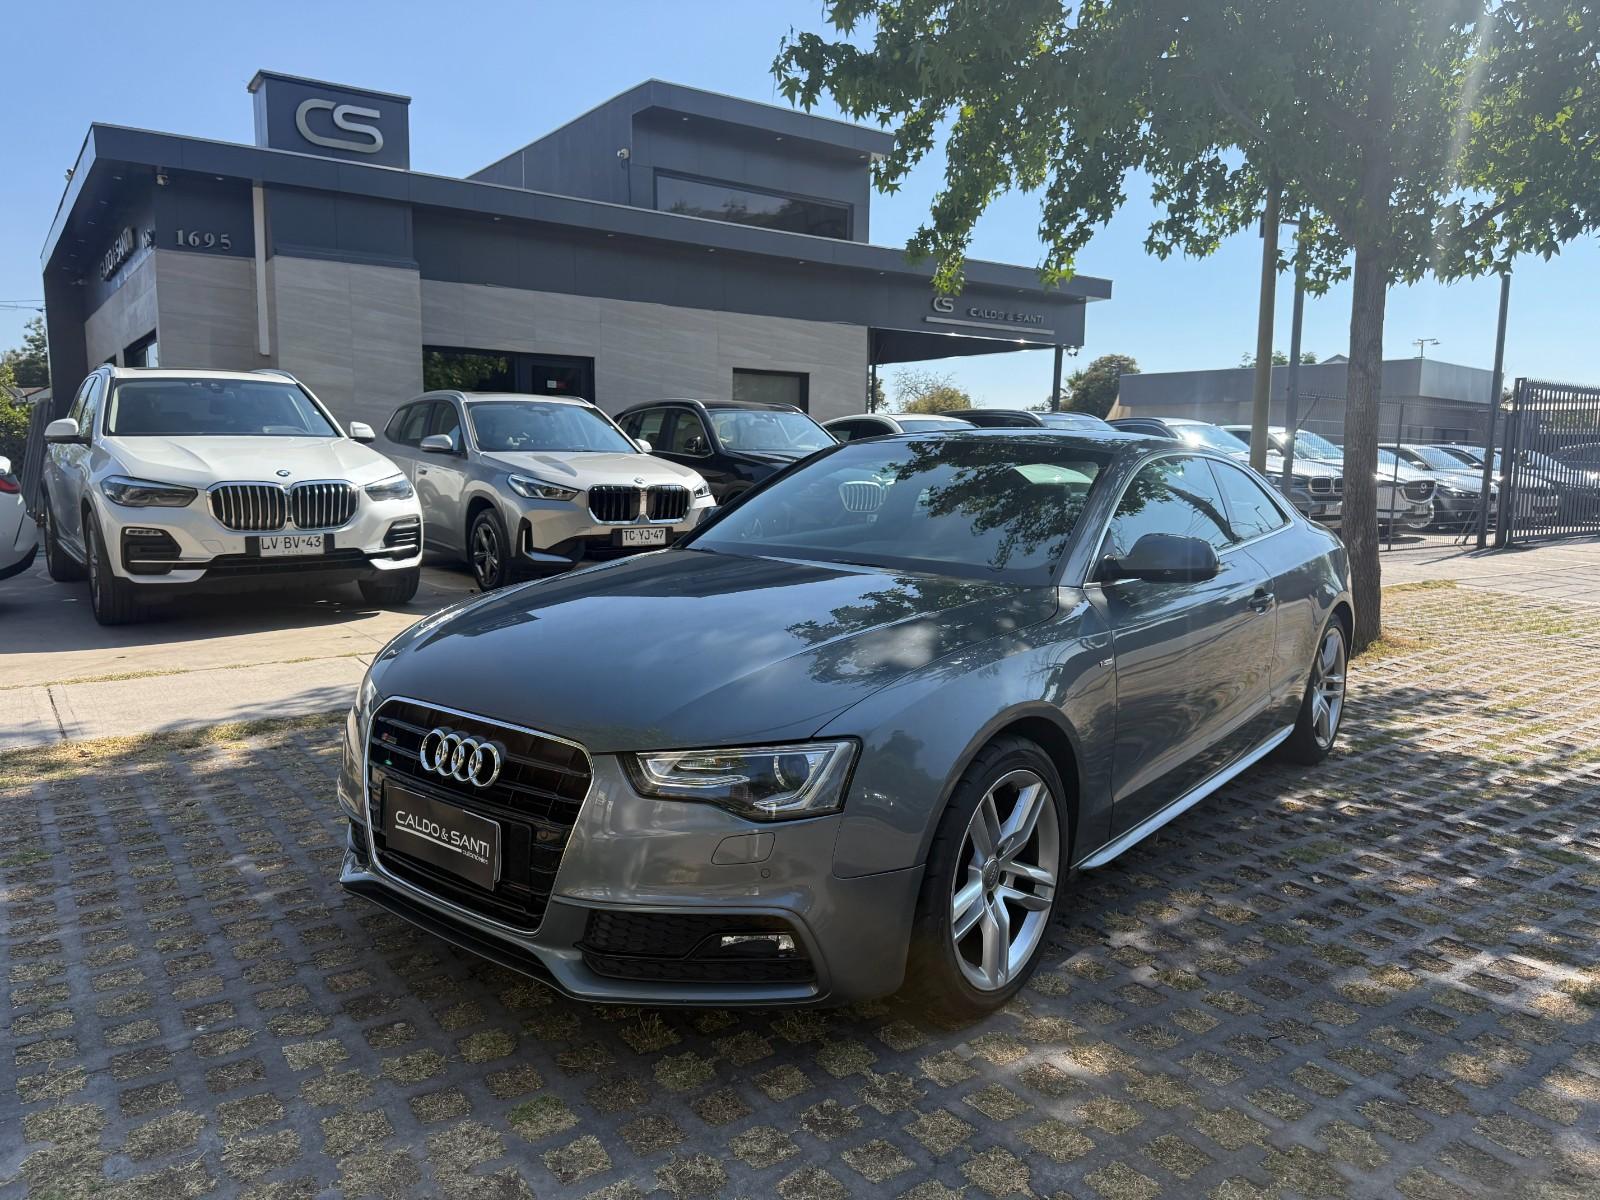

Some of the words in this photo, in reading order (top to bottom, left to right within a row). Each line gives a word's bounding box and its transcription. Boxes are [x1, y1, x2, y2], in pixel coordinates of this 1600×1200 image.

[296, 98, 384, 154] CS
[175, 229, 232, 250] 1695
[933, 296, 954, 313] CS
[970, 307, 1005, 321] CALDO
[1016, 313, 1044, 324] SANTI
[395, 810, 440, 837] CALDO
[441, 828, 449, 841] &
[450, 830, 490, 858] SANTI
